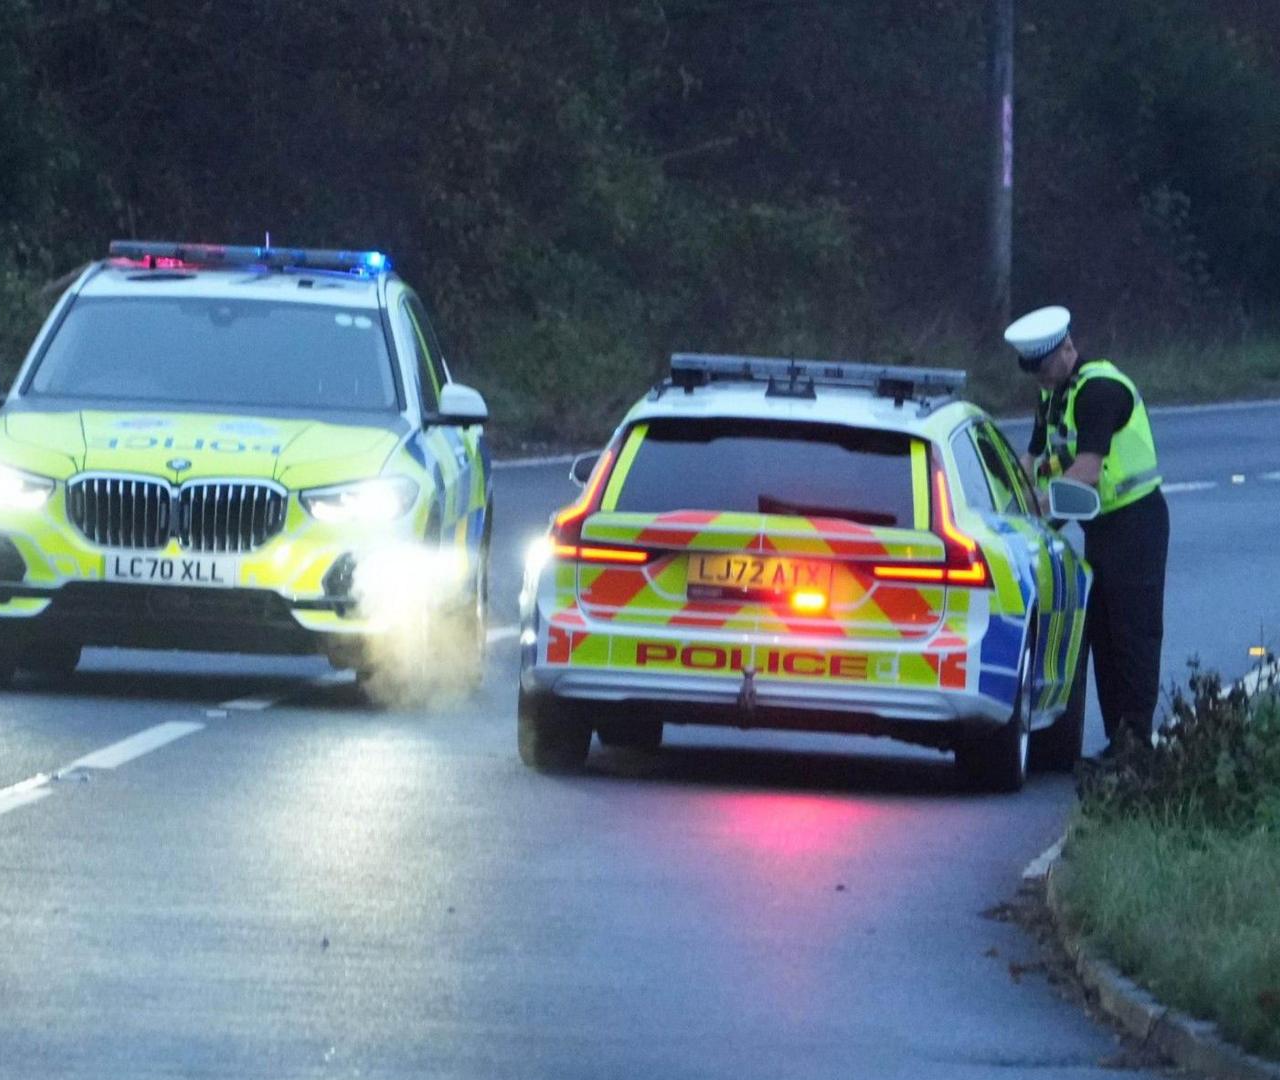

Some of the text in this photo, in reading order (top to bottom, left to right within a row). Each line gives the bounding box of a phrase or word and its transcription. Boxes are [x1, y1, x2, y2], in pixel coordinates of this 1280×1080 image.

[115, 555, 224, 583] LC70 XLL
[698, 556, 765, 584] LJ72
[636, 642, 869, 680] POLICE
